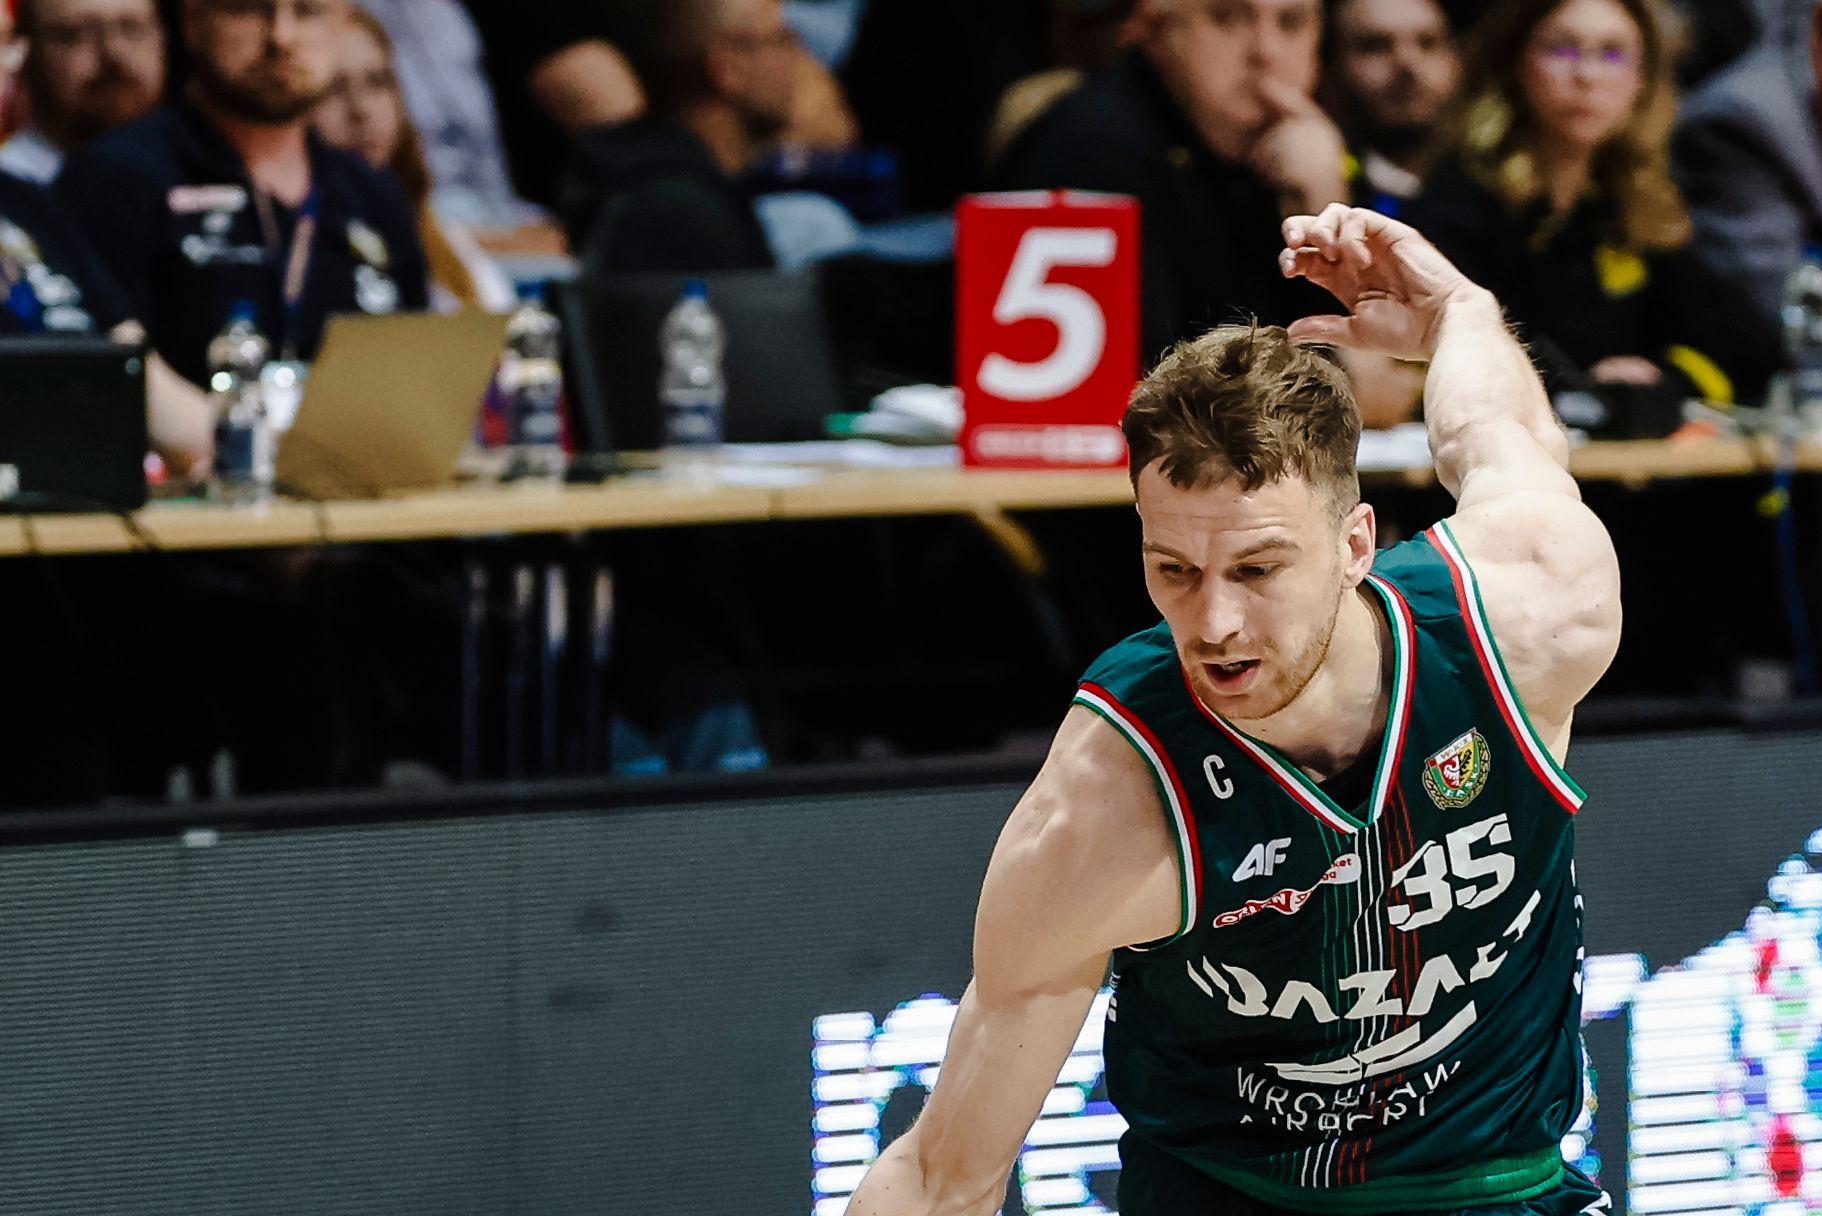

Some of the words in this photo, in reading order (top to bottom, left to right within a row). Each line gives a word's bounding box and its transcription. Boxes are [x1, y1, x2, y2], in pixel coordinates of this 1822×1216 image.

[976, 227, 1118, 402] 5
[1203, 754, 1234, 799] C
[1387, 813, 1515, 932] 35
